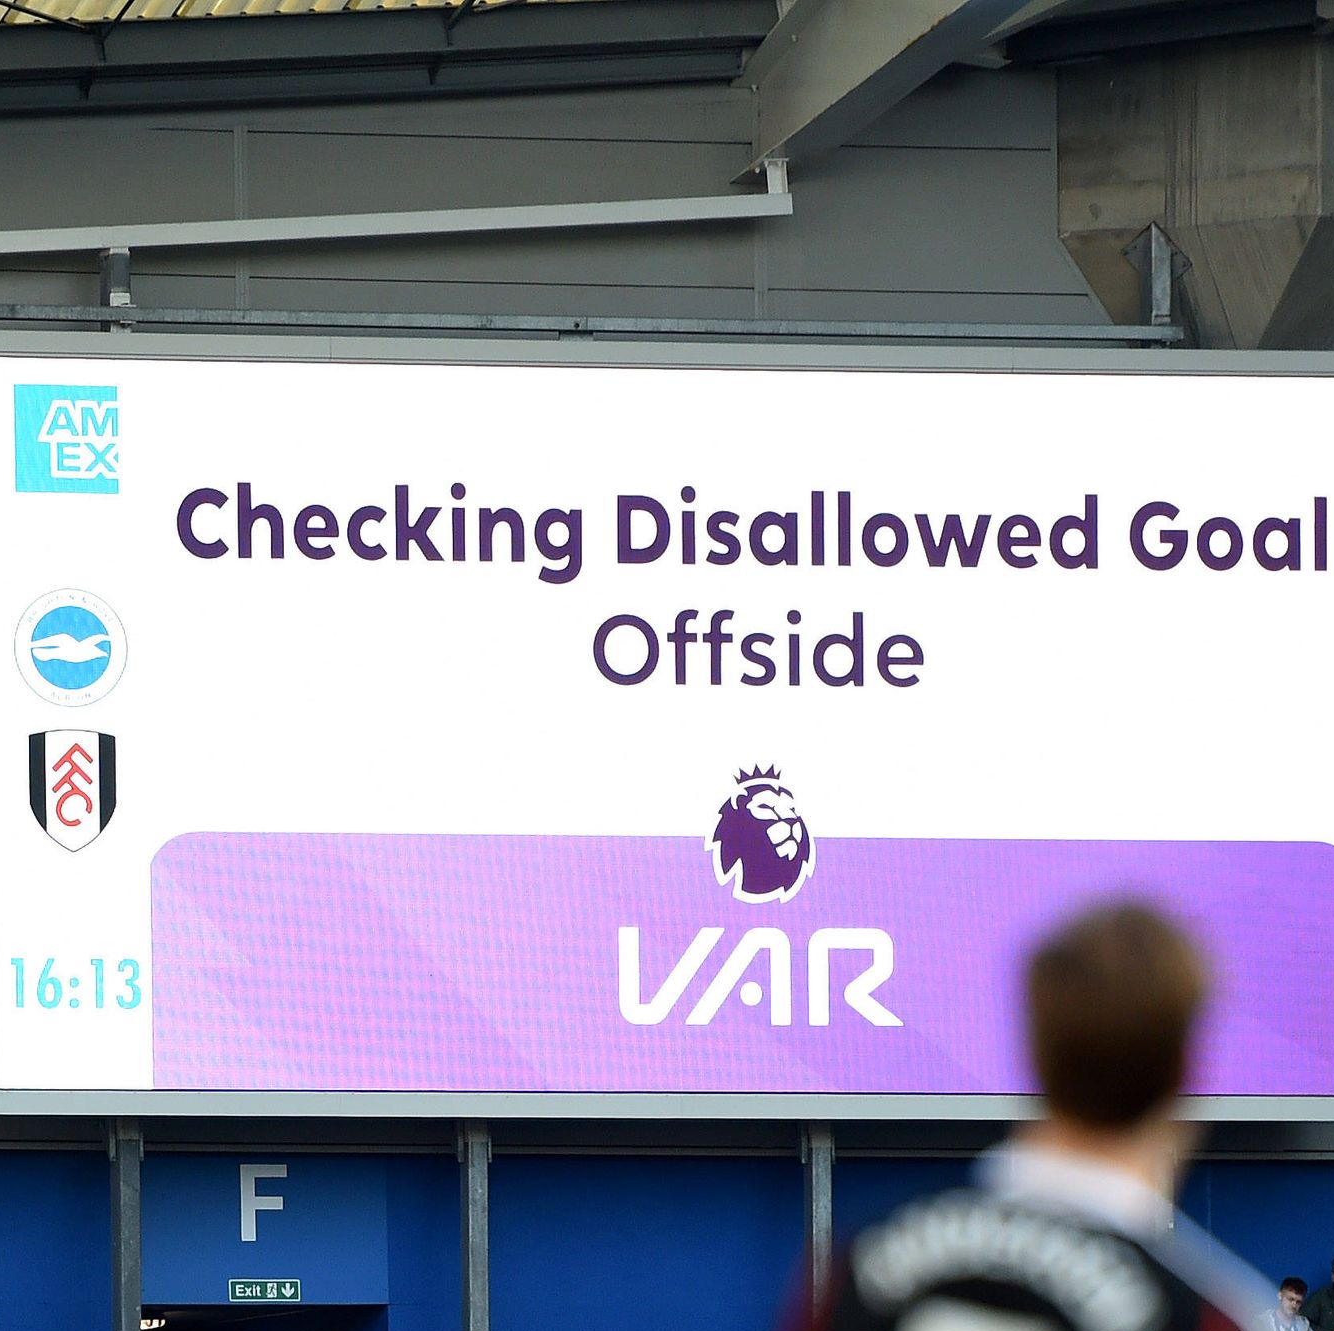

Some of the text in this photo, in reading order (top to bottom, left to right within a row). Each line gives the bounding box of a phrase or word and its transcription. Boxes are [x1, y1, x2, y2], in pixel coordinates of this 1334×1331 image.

[177, 482, 1329, 585] Checking Disallowed Goal
[593, 609, 924, 687] Offside
[11, 957, 142, 1010] 16:13
[617, 926, 904, 1028] VAR
[240, 1164, 288, 1242] F
[235, 1283, 261, 1298] Exit
